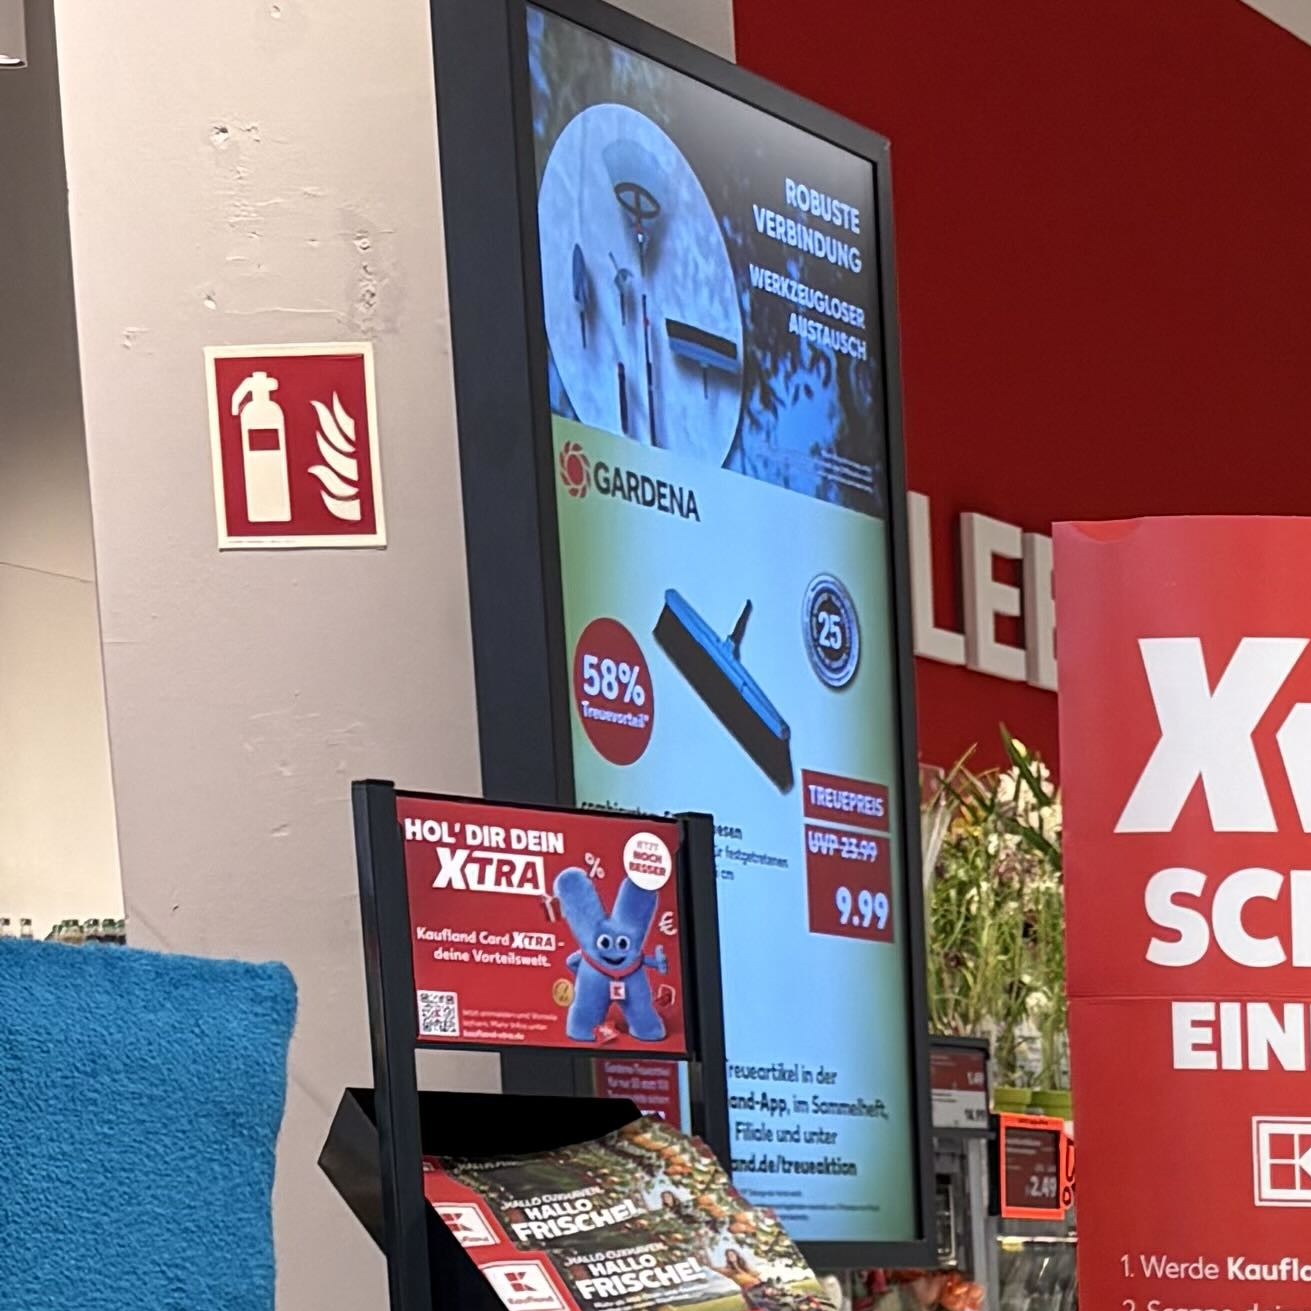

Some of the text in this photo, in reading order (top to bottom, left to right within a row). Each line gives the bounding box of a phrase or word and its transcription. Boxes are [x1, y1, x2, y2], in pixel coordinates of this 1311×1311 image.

[785, 177, 860, 234] ROBUSTE
[753, 204, 862, 273] VERBINDUNG
[749, 263, 865, 329] WERKZEUGLOSER
[788, 312, 867, 361] AUSTAUSCH
[594, 461, 701, 522] GARDENA
[817, 611, 842, 649] 25
[582, 655, 645, 706] 58%
[808, 784, 884, 818] TREUEPREIS
[464, 823, 506, 849] DIR
[510, 829, 565, 855] DEIN
[432, 847, 547, 895] XTRA
[836, 886, 889, 930] 9.99
[416, 926, 556, 951] Kaufland Card XTRA
[433, 947, 470, 962] deine
[815, 1066, 838, 1085] der
[735, 1122, 839, 1146] Filiale und unter
[511, 1199, 641, 1242] FRISCHE!
[524, 1199, 593, 1221] HALLO
[575, 1256, 707, 1300] FRISCHE!
[588, 1254, 657, 1277] HALLO
[1121, 1255, 1134, 1279] 1.
[1140, 1255, 1220, 1281] Werde
